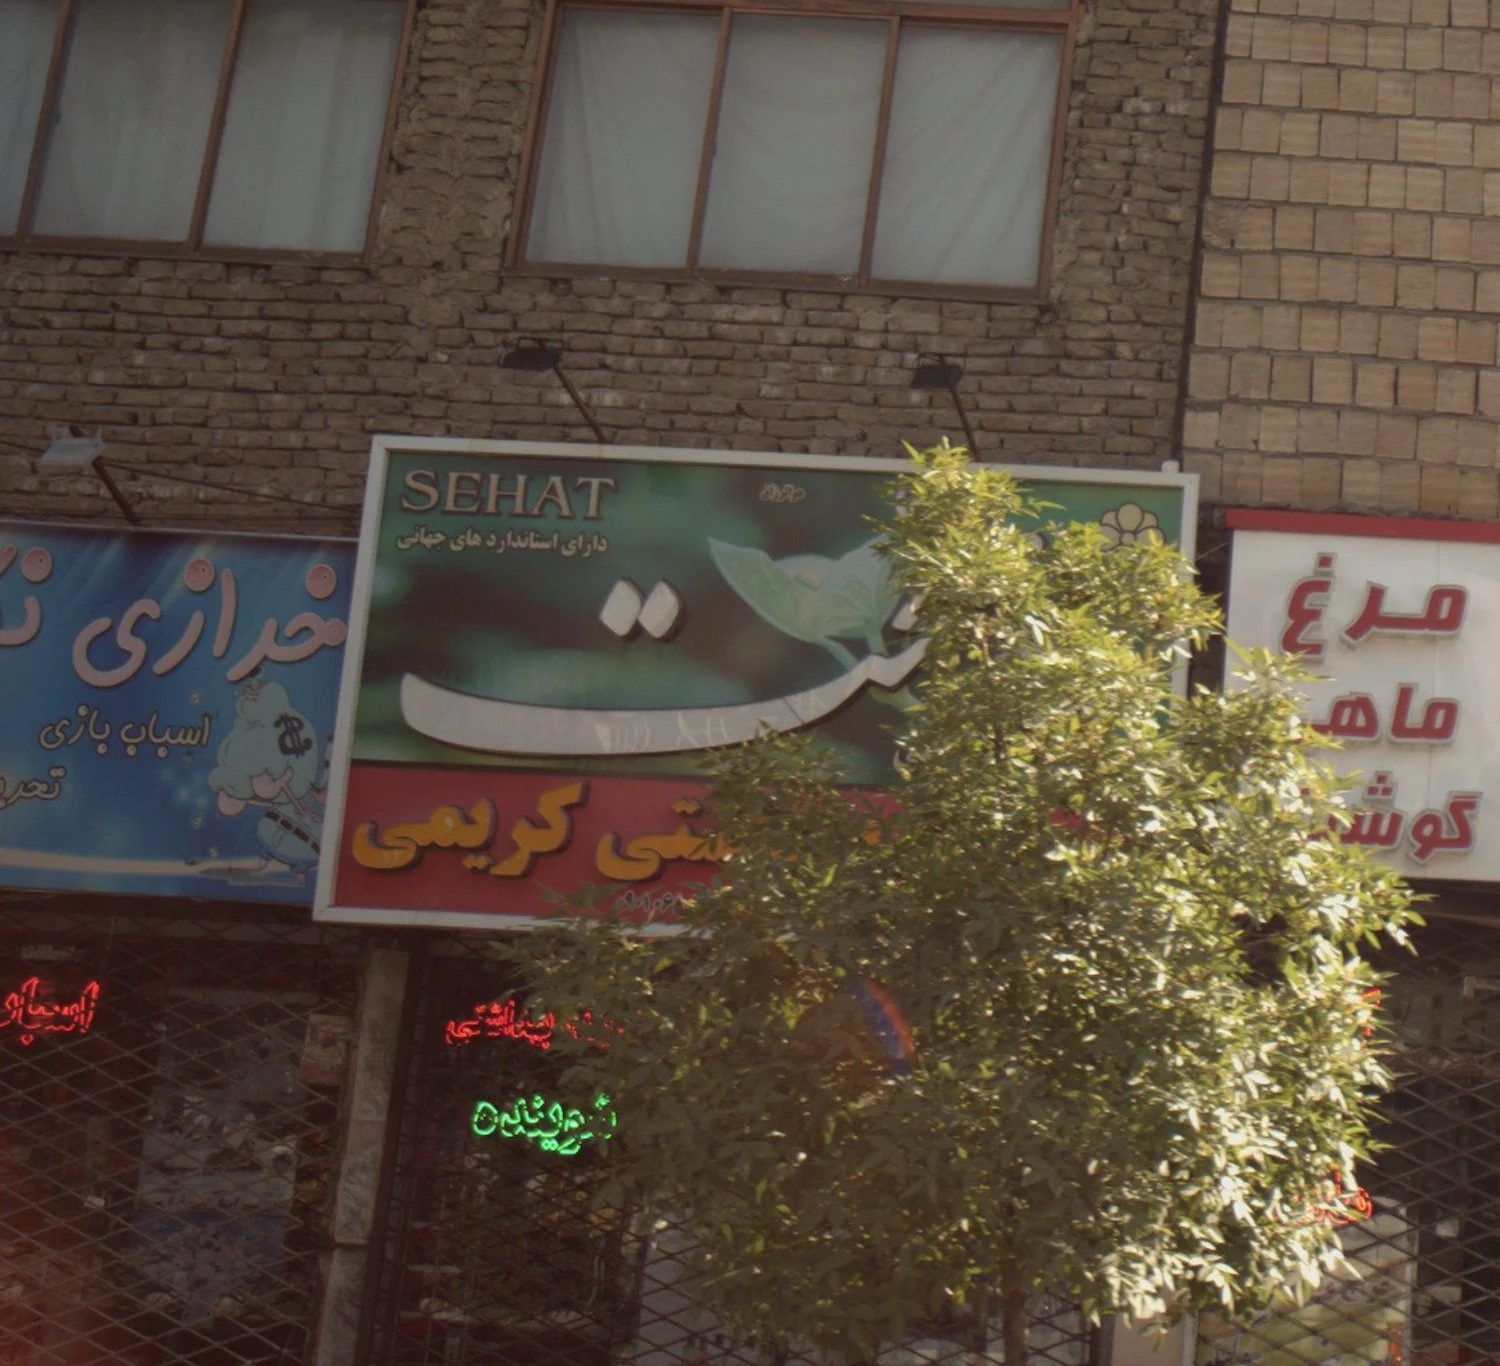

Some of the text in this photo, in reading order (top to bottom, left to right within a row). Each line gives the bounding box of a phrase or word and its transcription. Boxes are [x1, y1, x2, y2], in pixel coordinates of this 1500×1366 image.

[401, 469, 618, 519] SEHAT
[396, 523, 609, 558] دارای استاندارد های جهانی
[71, 556, 347, 688] خرازی
[1280, 552, 1470, 660] مرغ
[38, 703, 212, 759] اسباب بازی
[1300, 682, 1461, 744] ماه
[352, 782, 590, 876] کریمی
[1298, 770, 1483, 865] گوش
